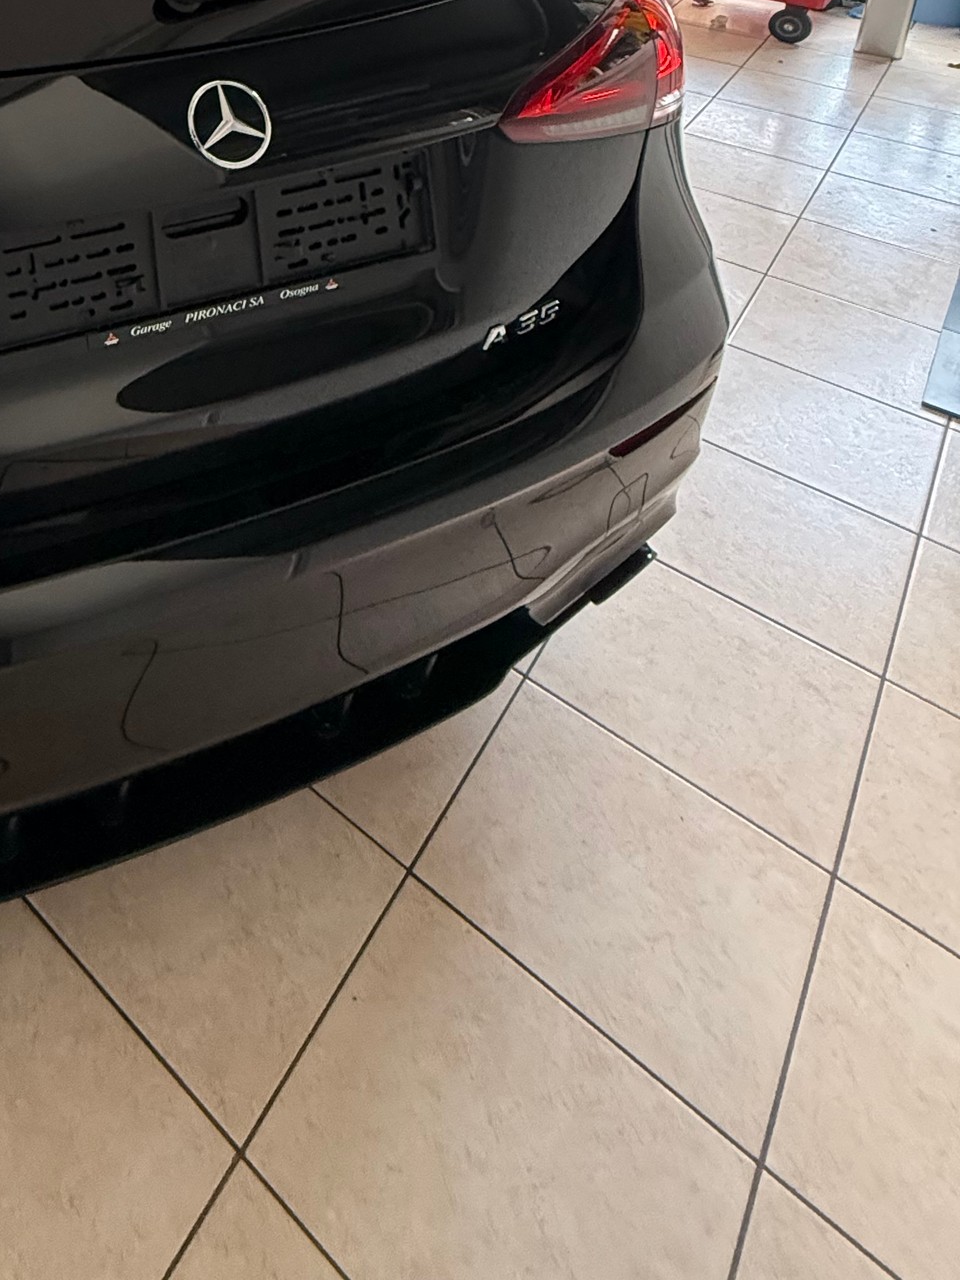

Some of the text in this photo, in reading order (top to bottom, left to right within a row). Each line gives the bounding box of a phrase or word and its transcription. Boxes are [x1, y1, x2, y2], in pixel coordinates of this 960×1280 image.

[130, 283, 319, 337] Garage PIRONACI SA Osogna
[482, 299, 560, 351] A 35
